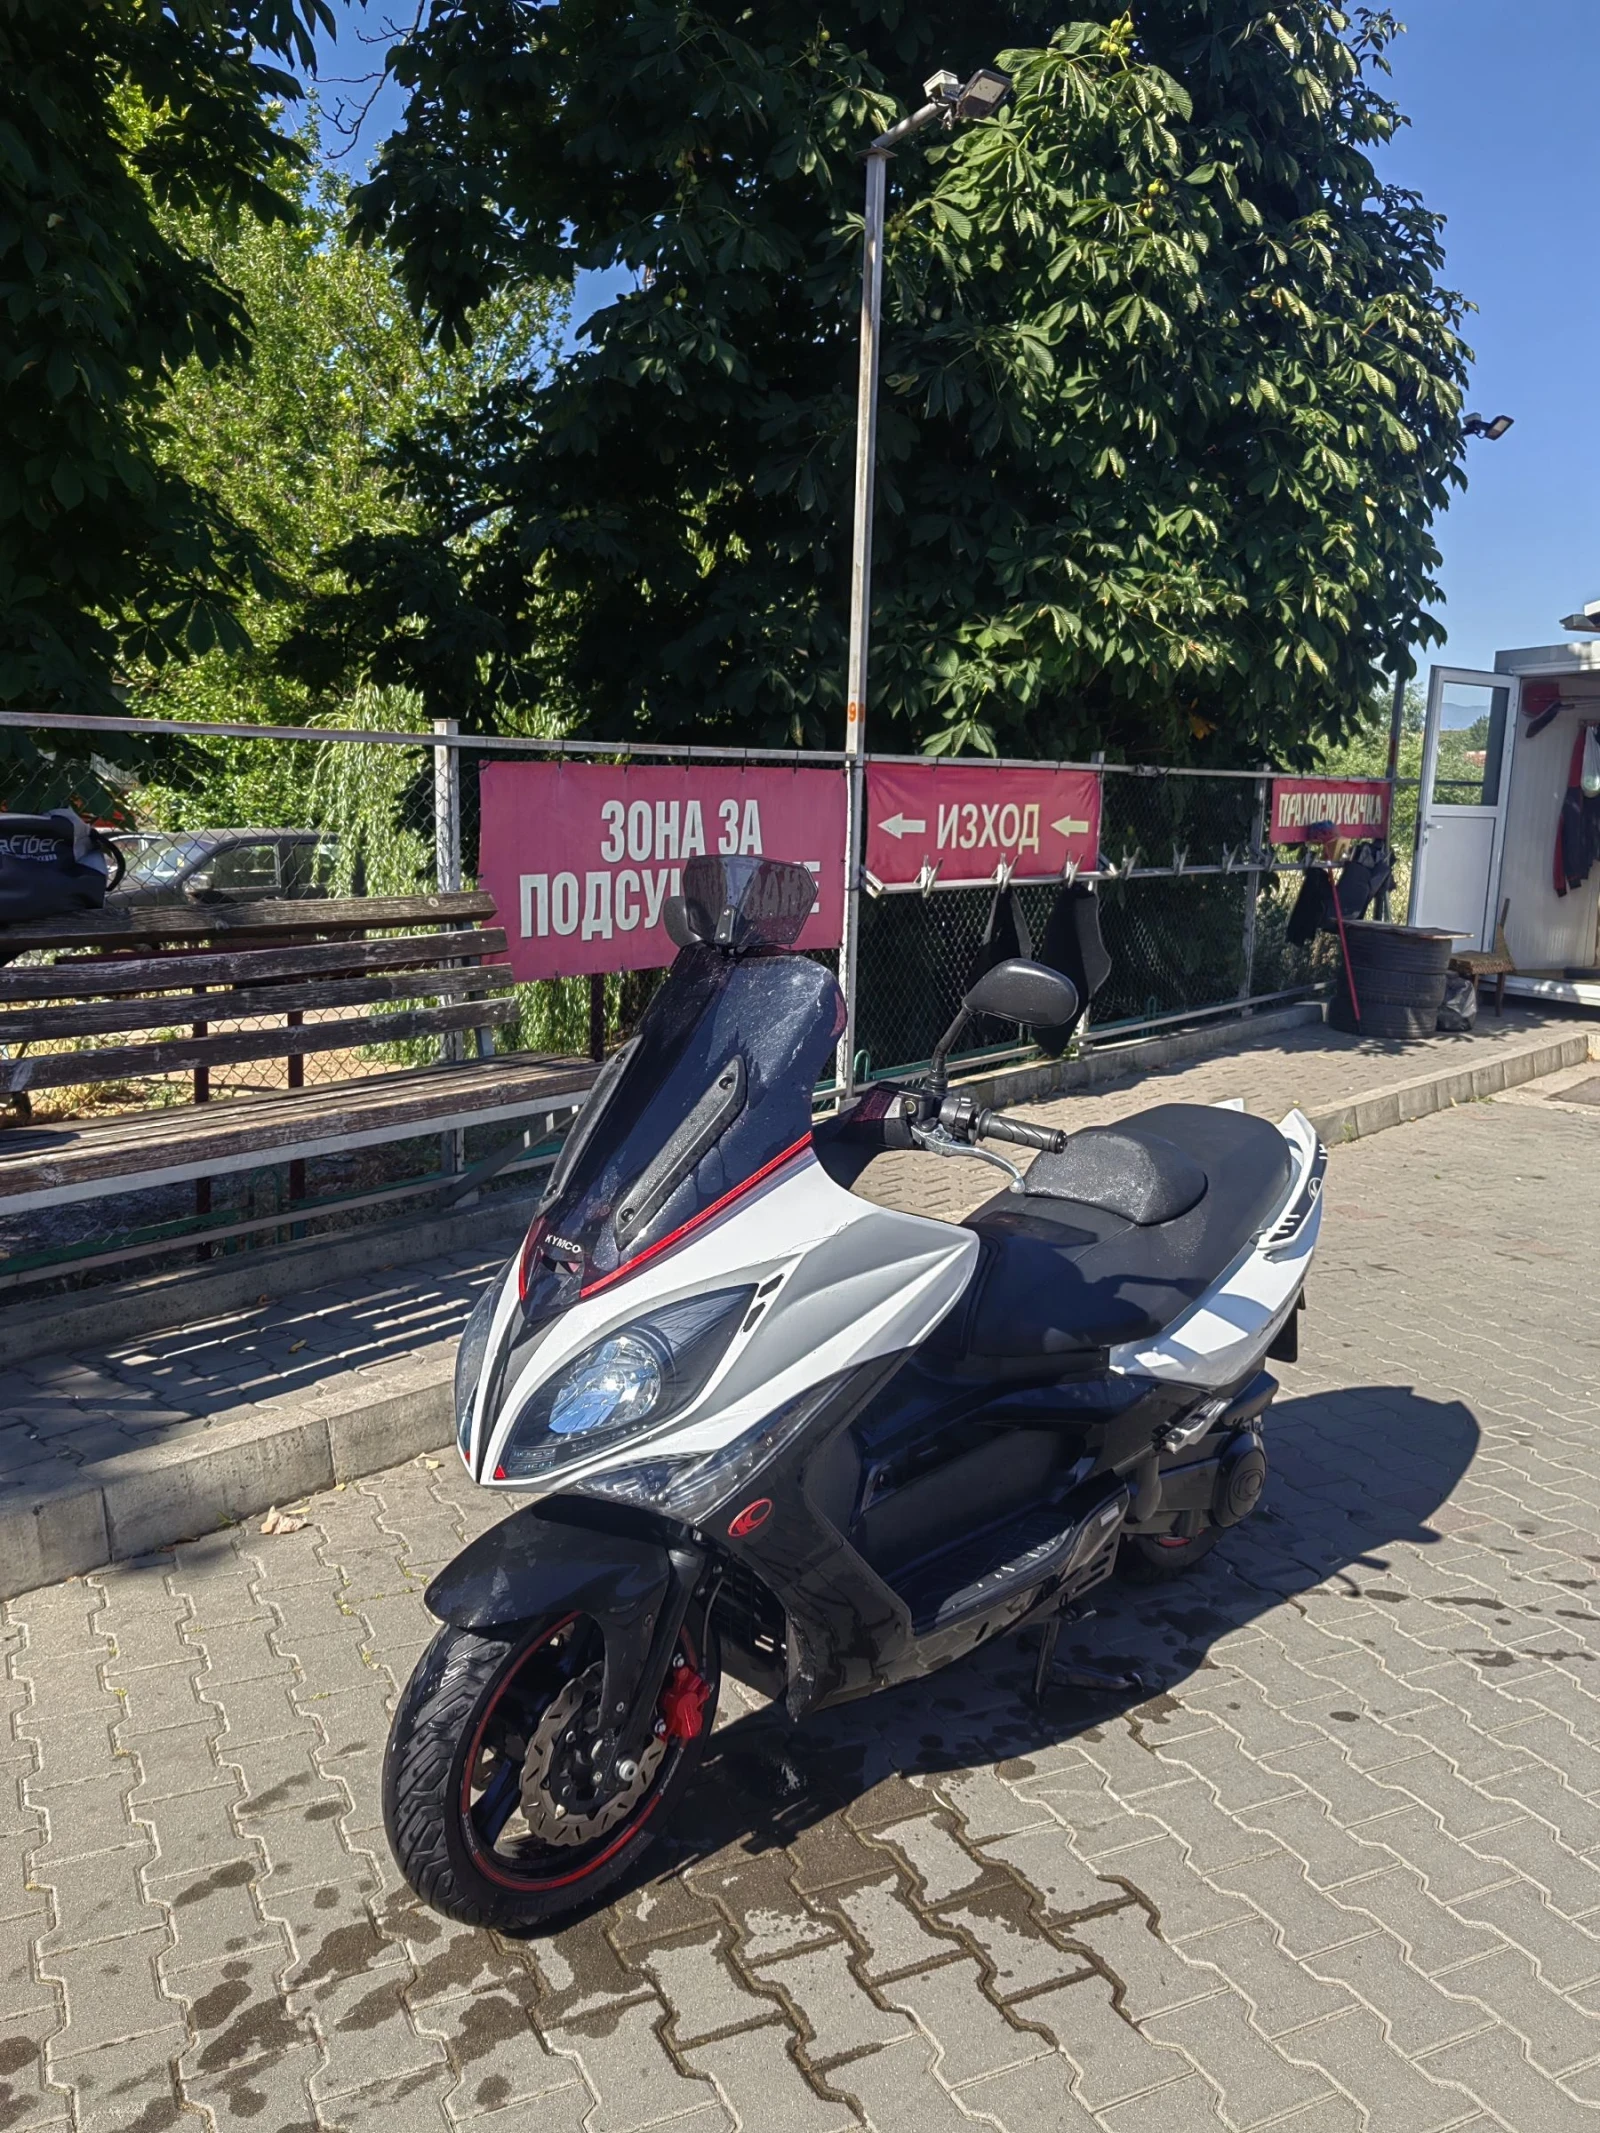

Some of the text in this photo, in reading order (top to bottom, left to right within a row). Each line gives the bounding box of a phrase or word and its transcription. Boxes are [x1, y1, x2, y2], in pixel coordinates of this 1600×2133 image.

[601, 799, 762, 862] ЗОНА ЗА
[937, 804, 1040, 854] ИЗХОД
[1278, 793, 1382, 827] ПРАХОСМУКАЧКА
[545, 1234, 582, 1253] KYMCO
